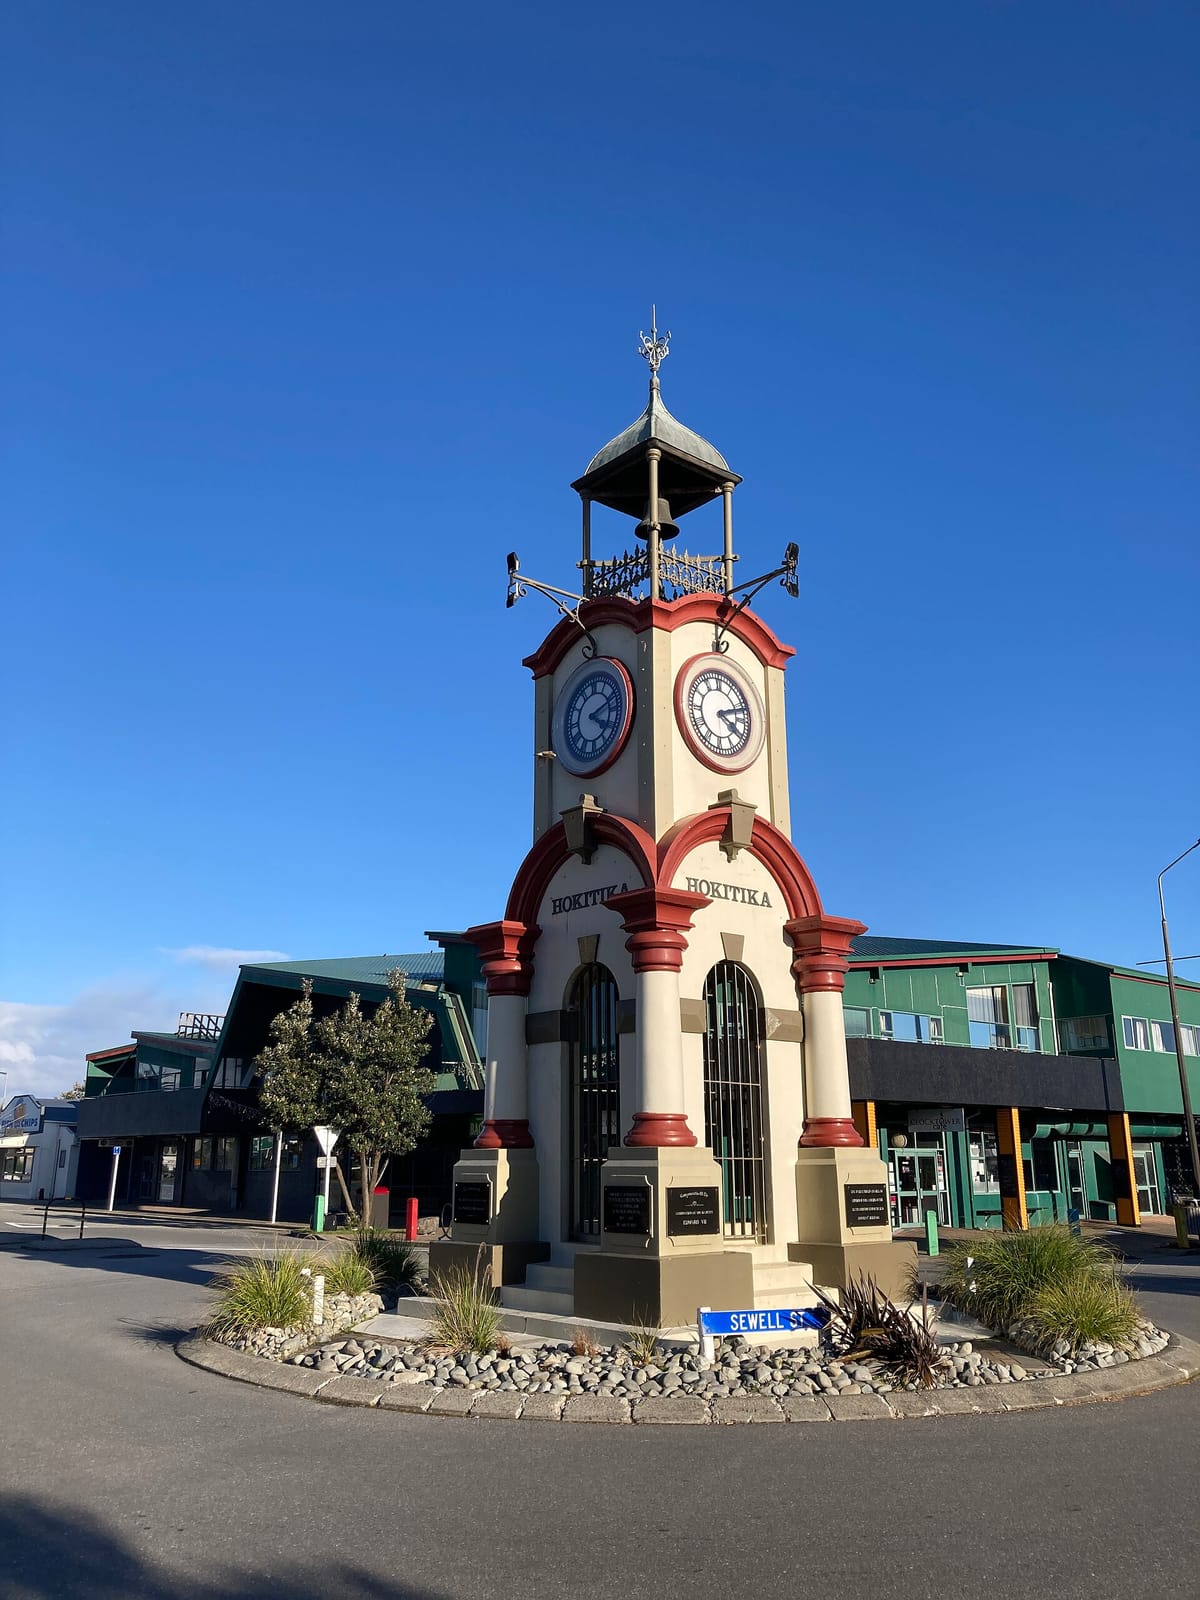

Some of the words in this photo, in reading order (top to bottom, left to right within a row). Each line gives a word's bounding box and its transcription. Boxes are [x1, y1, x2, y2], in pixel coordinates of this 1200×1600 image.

[551, 883, 628, 914] HOKITIKA
[686, 877, 772, 908] HOKITIKA
[21, 1118, 38, 1128] CHIPS
[730, 1312, 784, 1331] SEWELL
